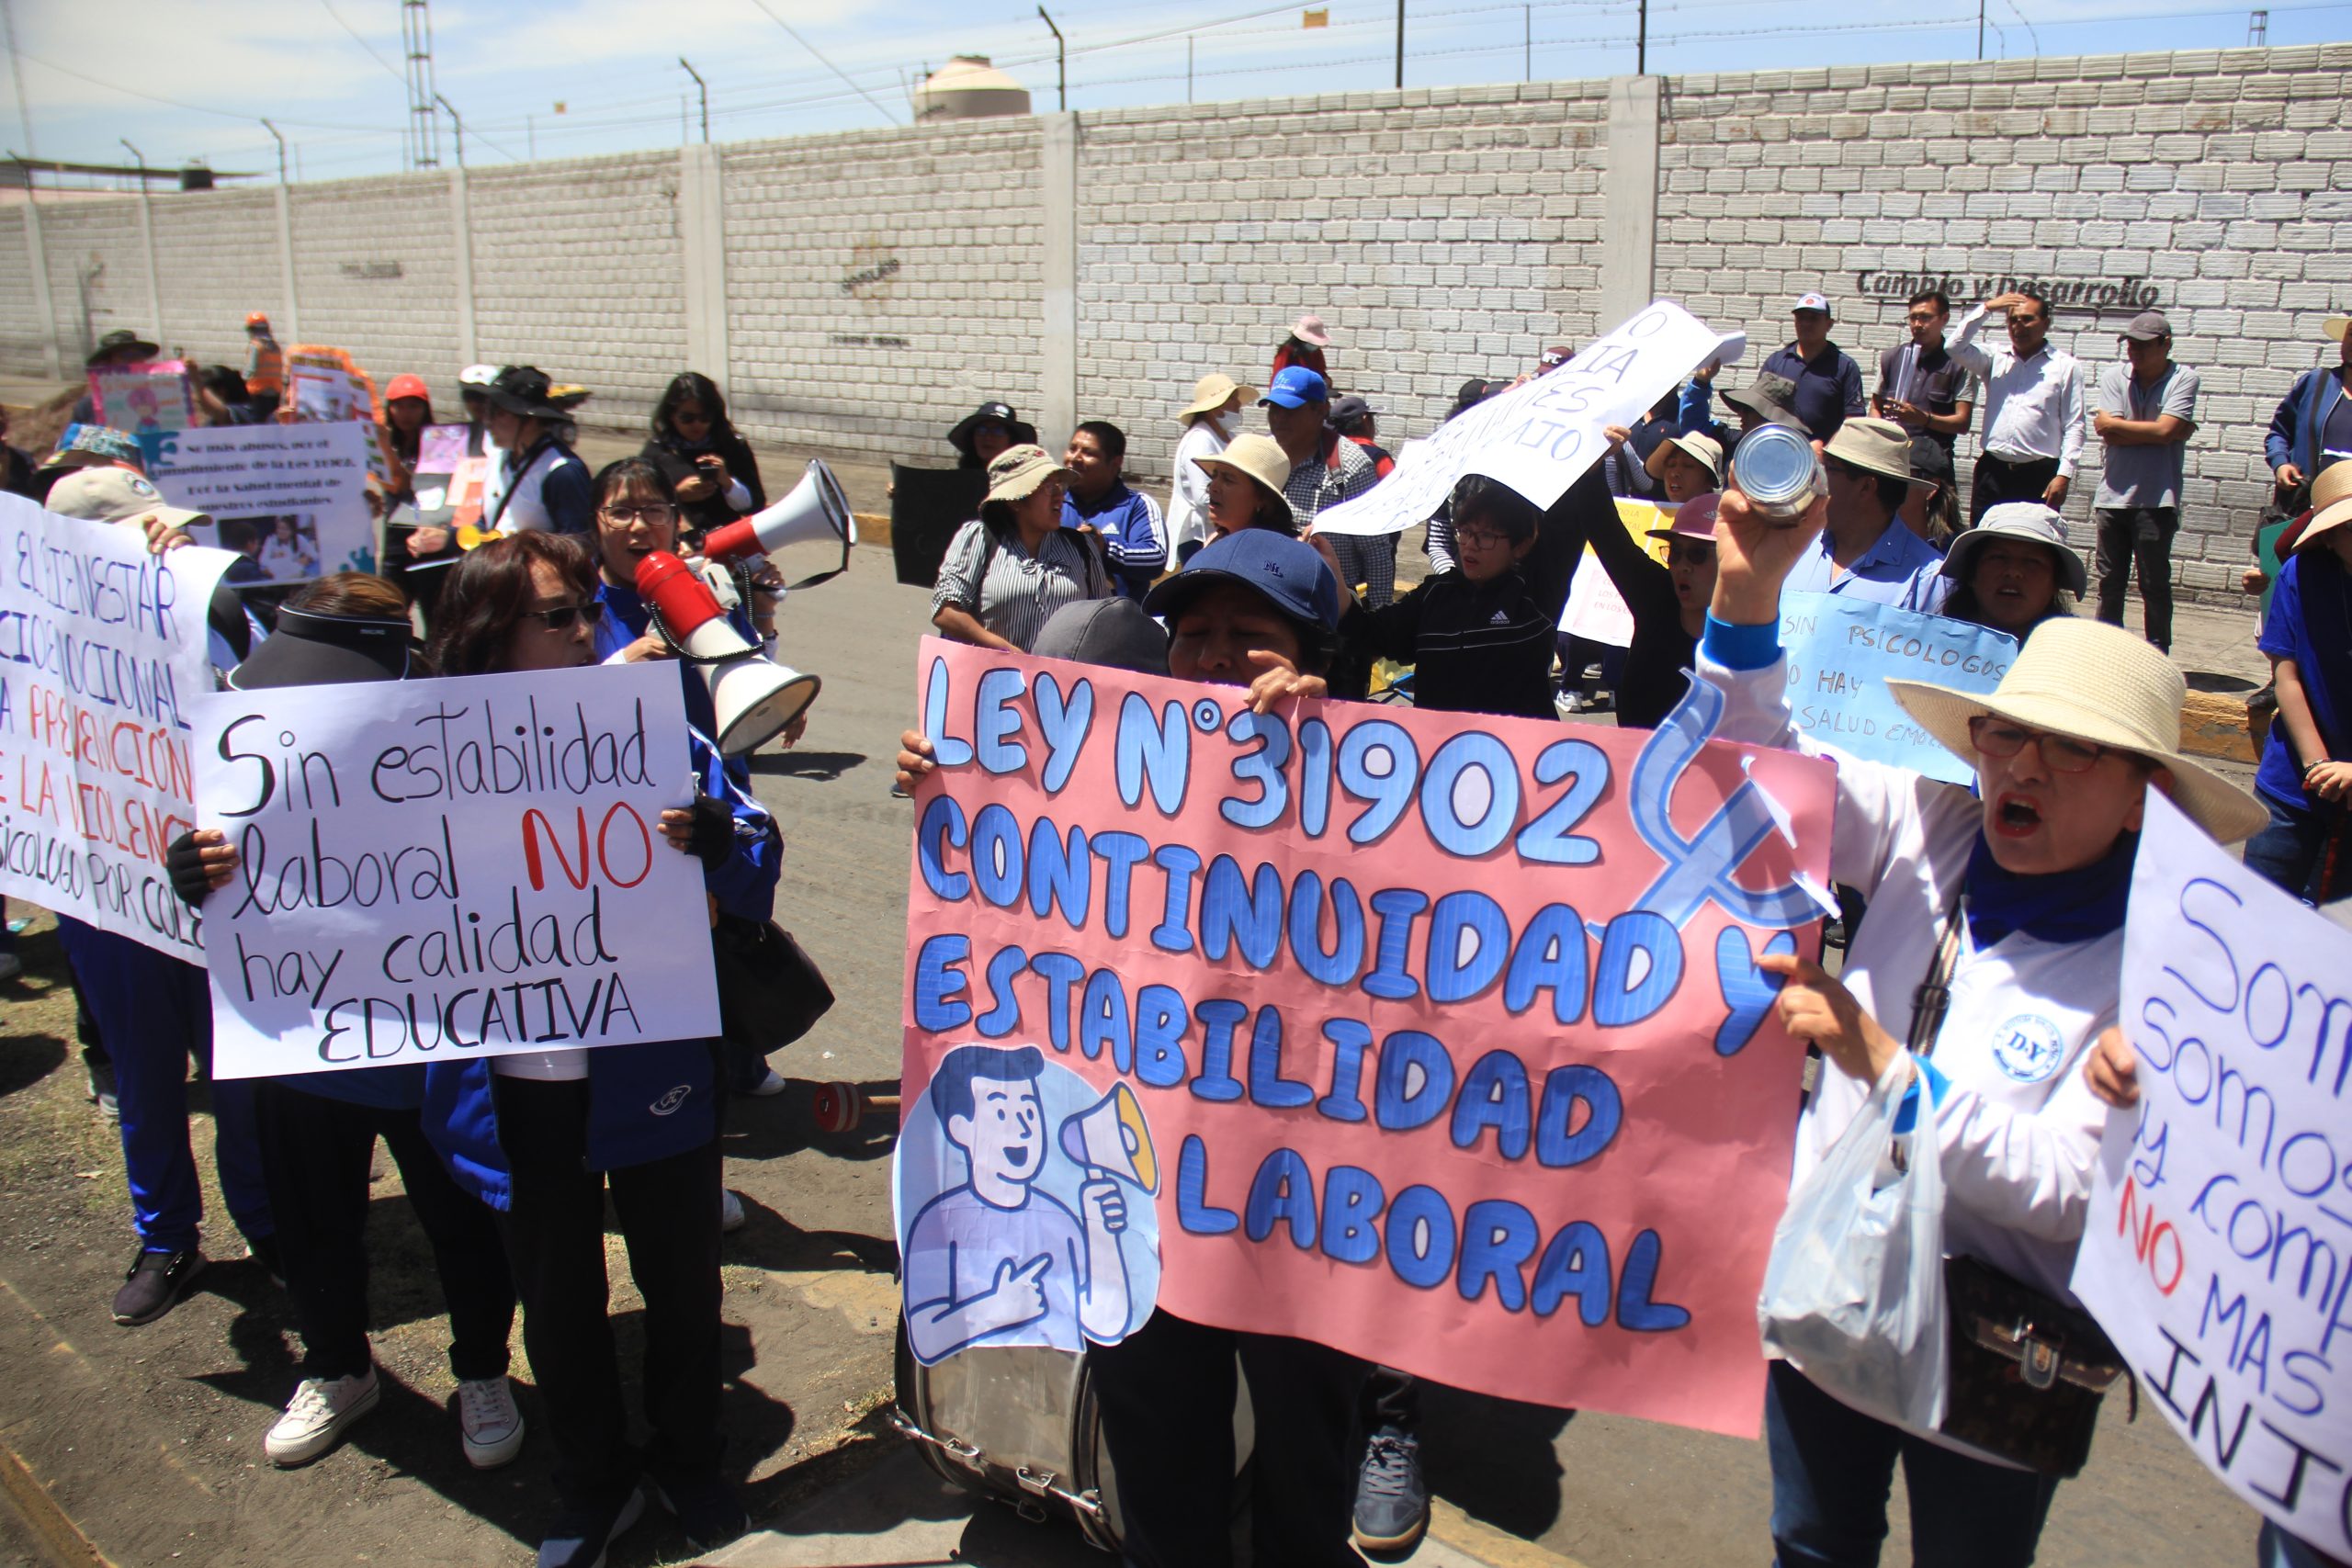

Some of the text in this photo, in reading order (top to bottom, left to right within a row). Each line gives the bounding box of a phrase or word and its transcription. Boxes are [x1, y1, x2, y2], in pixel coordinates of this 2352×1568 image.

[1781, 615, 1818, 637] SIN
[1817, 670, 1863, 699] HAY
[218, 694, 657, 818] Sin estabilidad
[928, 655, 1093, 795] LEY
[1800, 705, 1876, 736] SALUD
[21, 753, 61, 827] LA
[87, 852, 140, 925] POR
[230, 800, 654, 920] laboral NO
[236, 884, 619, 1009] hay calidad
[919, 793, 1796, 1057] CONTINUIDAD Y
[317, 971, 642, 1065] EDUCATIVA
[913, 932, 1624, 1169] ESTABILIDAD
[2131, 1098, 2169, 1190] y
[1174, 1134, 1691, 1333] LABORAL
[2117, 1174, 2335, 1417] NO MAS
